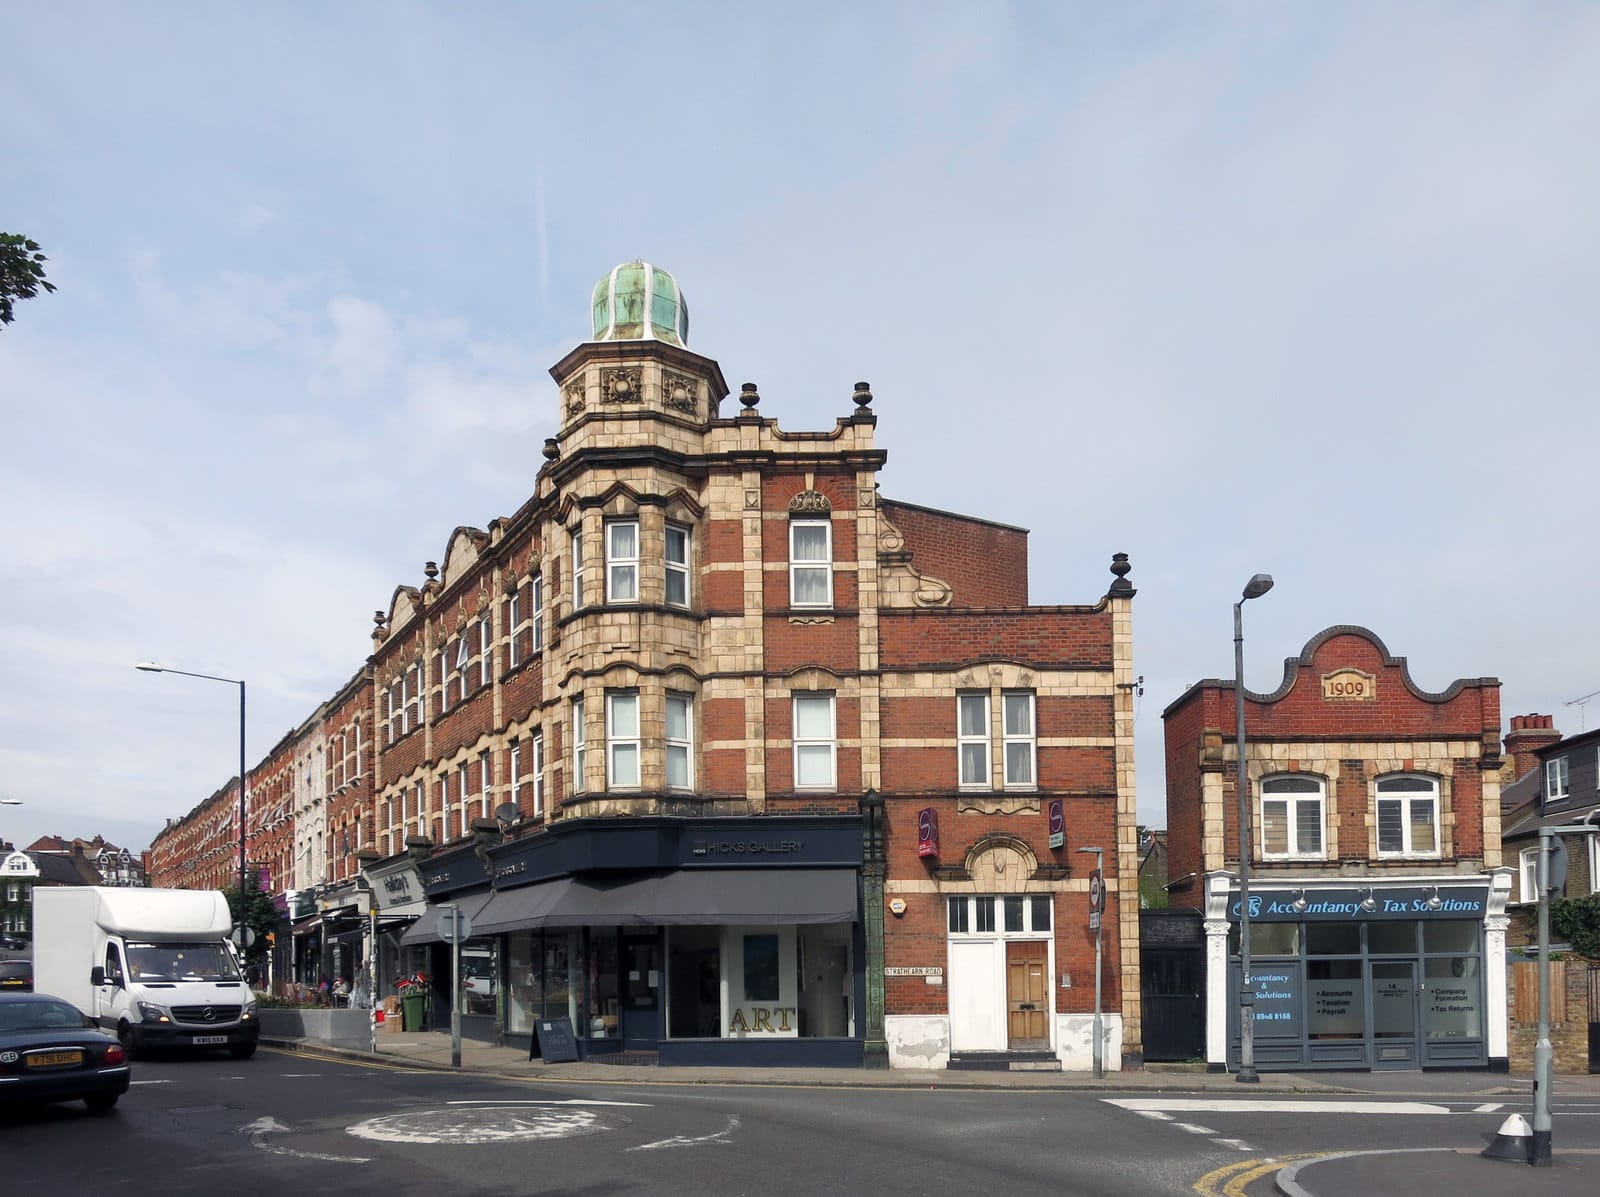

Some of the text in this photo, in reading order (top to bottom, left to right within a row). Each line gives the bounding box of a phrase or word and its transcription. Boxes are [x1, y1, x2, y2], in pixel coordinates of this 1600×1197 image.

[1330, 682, 1364, 696] 1909
[708, 840, 803, 853] HICKS GALLERY
[1266, 901, 1361, 917] Accuntancy
[1383, 899, 1408, 912] Tax
[1411, 899, 1481, 912] Soutions
[885, 967, 942, 976] STRATHEARN ROAD
[1255, 991, 1292, 999] Solutions
[1322, 1008, 1346, 1016] Payroll
[729, 1007, 796, 1034] ART
[1, 1052, 17, 1061] GB
